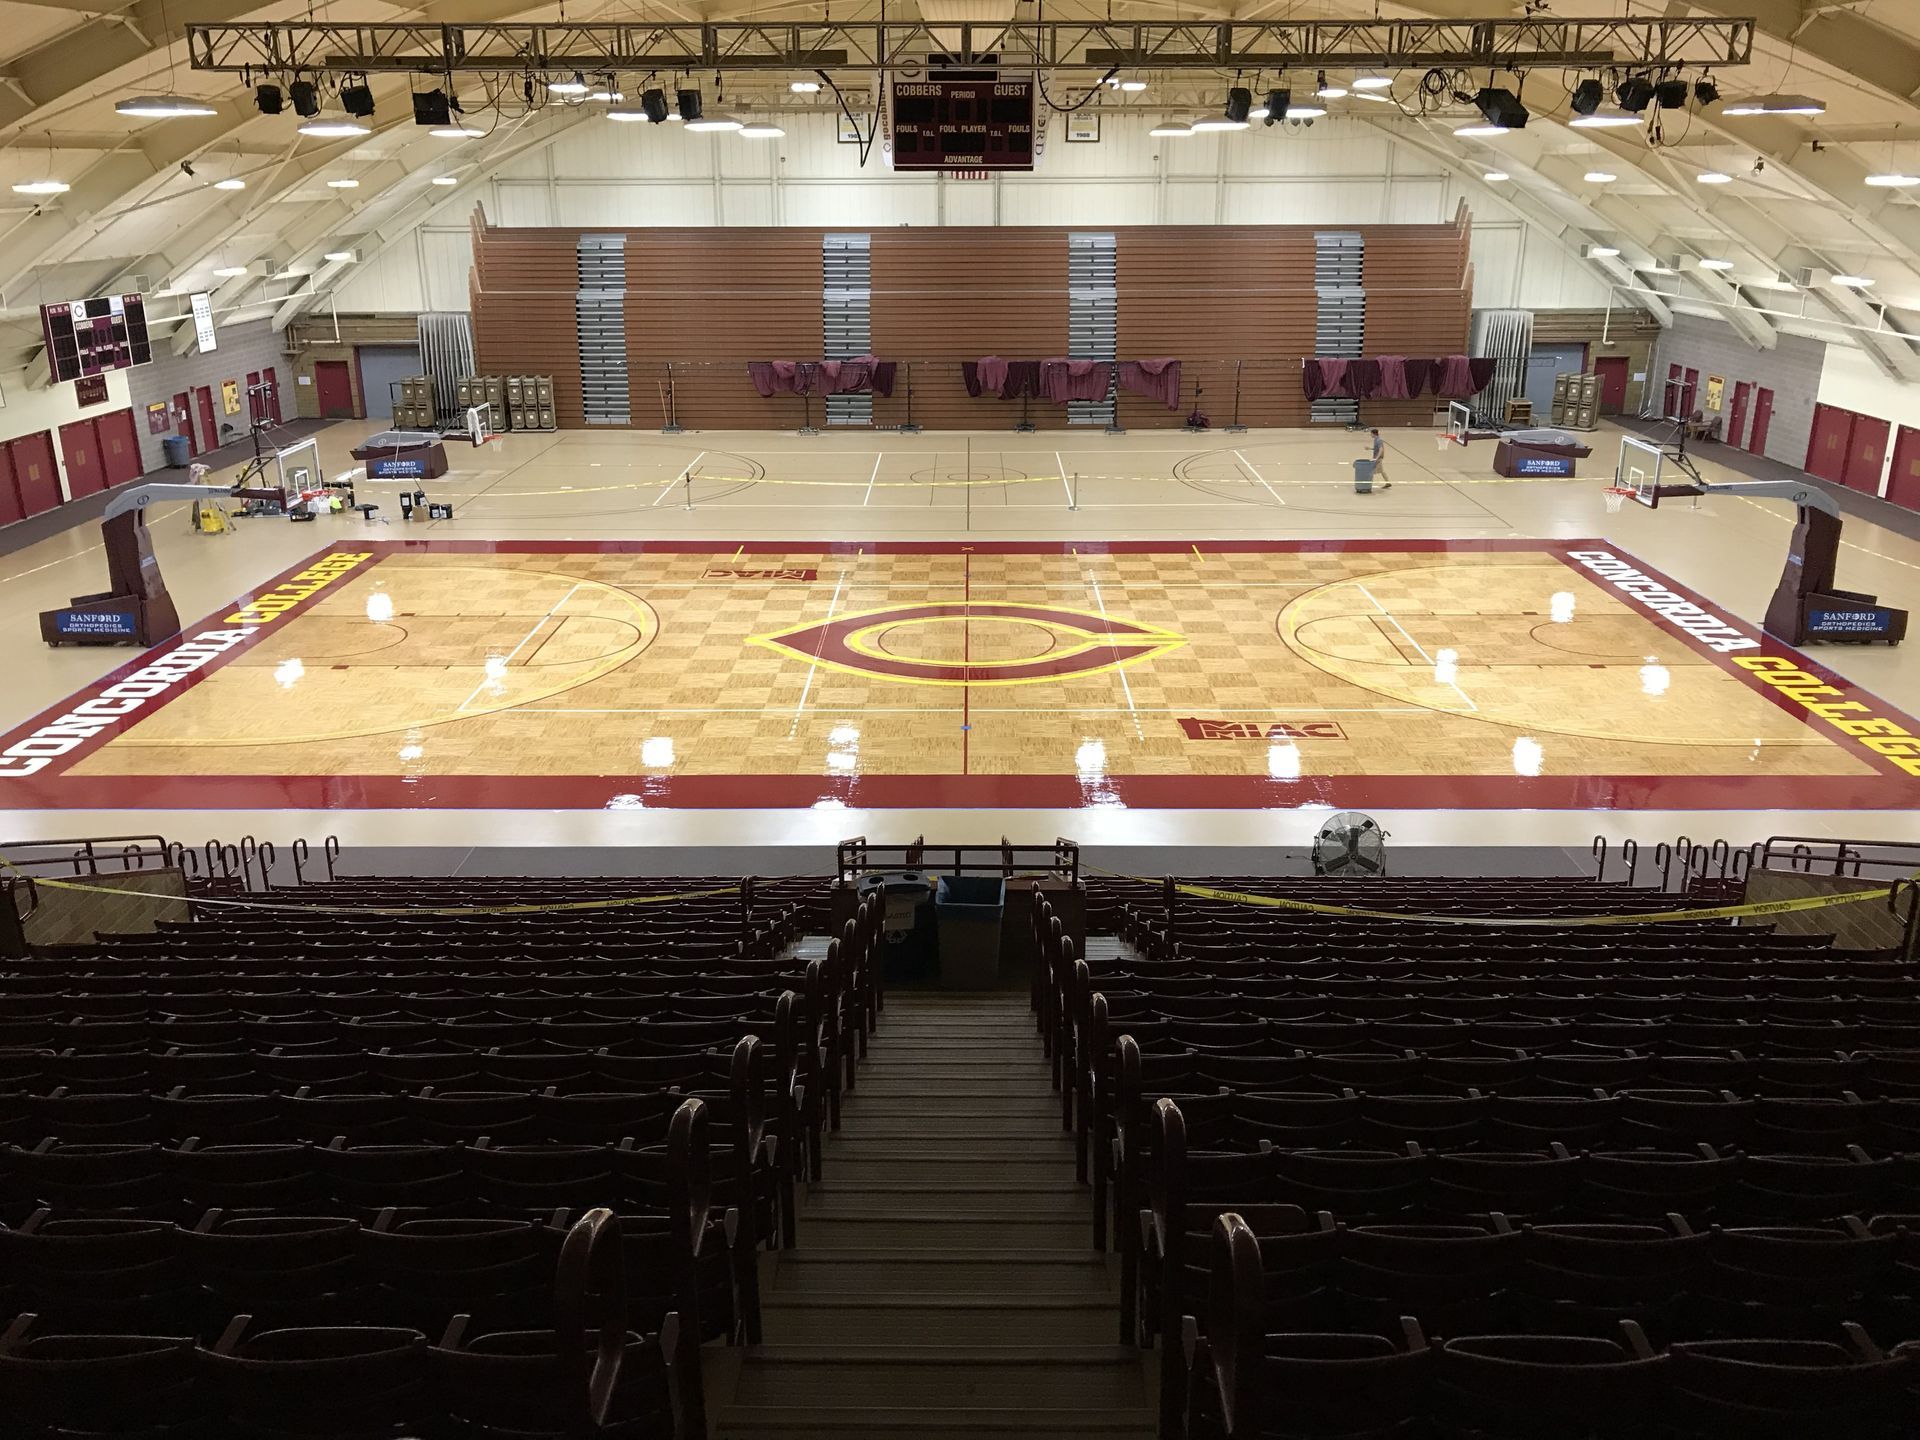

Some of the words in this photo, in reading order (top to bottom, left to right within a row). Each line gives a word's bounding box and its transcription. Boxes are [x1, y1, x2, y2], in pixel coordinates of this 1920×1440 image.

[896, 85, 942, 96] COBBERS
[950, 90, 976, 99] PERIOD
[994, 85, 1028, 96] GUEST
[1034, 72, 1050, 156] ANFORD
[896, 125, 918, 133] FOULS
[939, 125, 957, 133] FOUL
[961, 125, 987, 133] PLAYER
[1008, 125, 1030, 133] FOULS
[944, 155, 983, 164] ADVANTAGE
[1567, 551, 1761, 652] CONCORDIA
[70, 614, 121, 622] SANFORD
[0, 626, 261, 777] CONCORDIA
[223, 552, 374, 624] COLLEGE
[1203, 723, 1340, 738] MIAC
